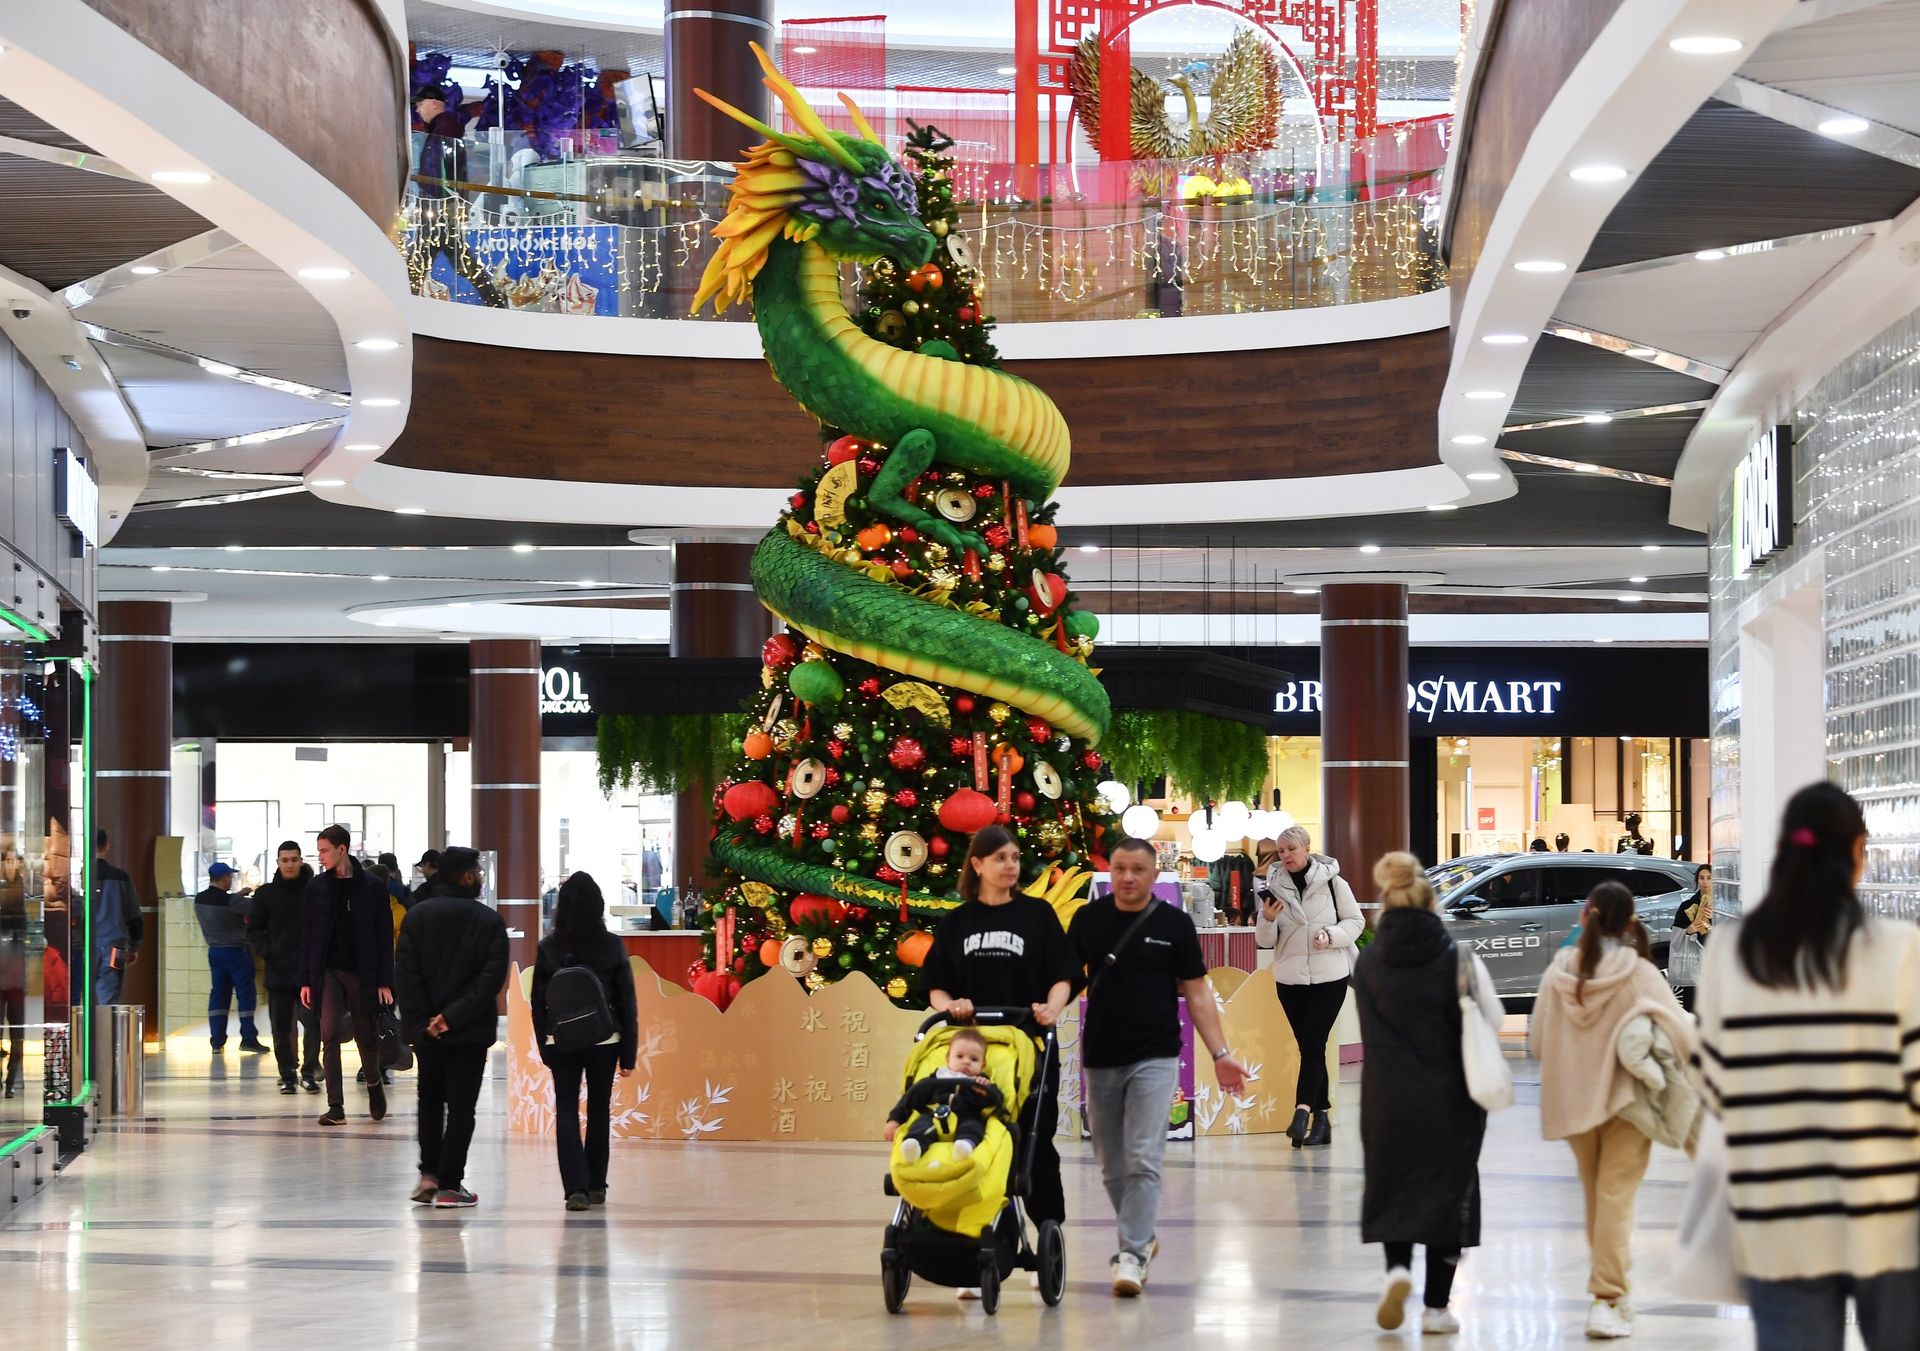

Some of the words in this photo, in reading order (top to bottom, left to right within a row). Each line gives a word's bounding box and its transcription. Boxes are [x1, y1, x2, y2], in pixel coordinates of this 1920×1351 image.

[1273, 675, 1561, 723] BRS/MART
[963, 932, 982, 956] LOS
[981, 930, 1025, 957] ANGELES
[1456, 936, 1540, 951] XEED
[770, 1106, 798, 1135] 酒
